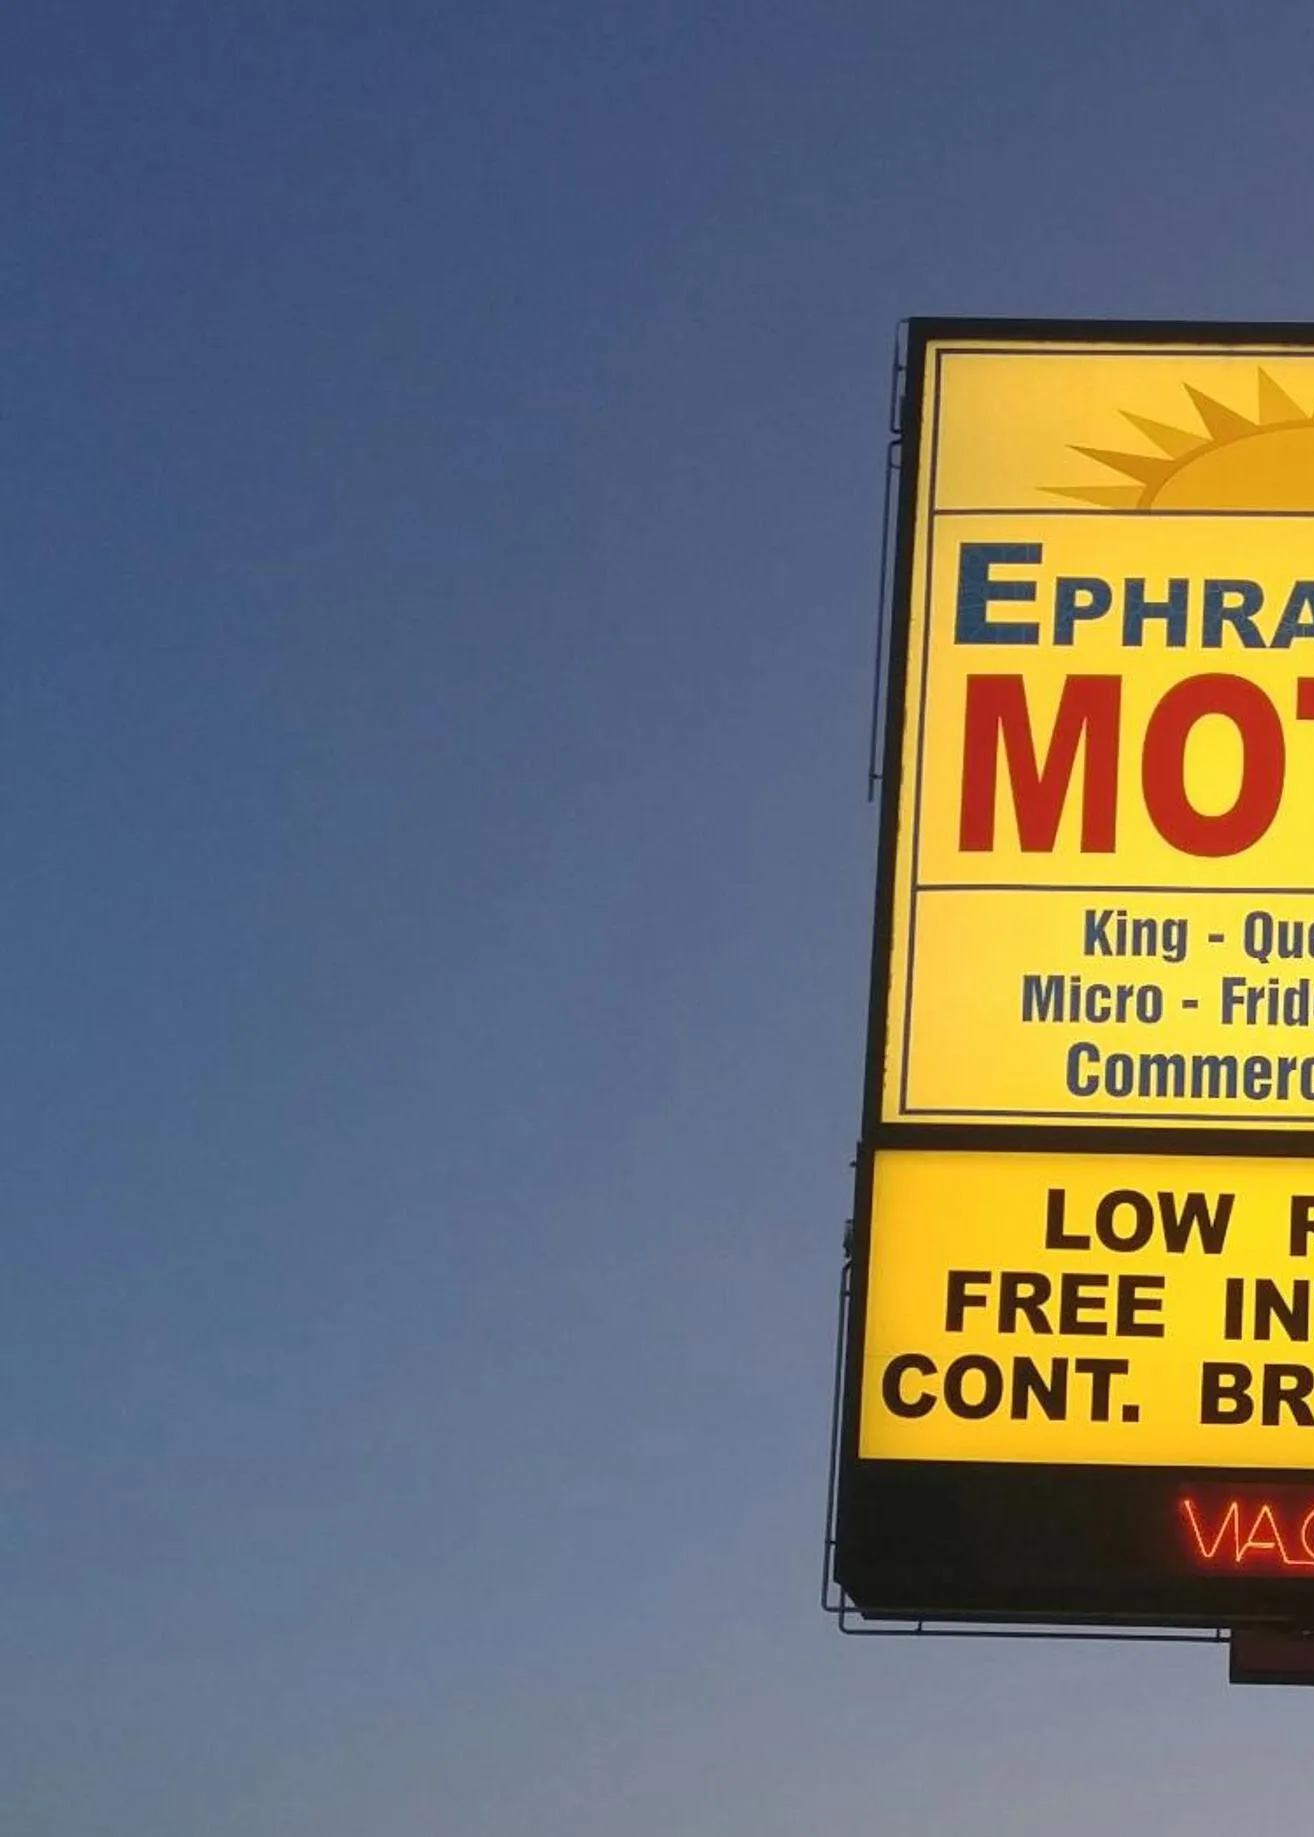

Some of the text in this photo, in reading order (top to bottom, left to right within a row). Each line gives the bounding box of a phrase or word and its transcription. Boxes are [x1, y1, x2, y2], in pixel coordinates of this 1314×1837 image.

[1084, 909, 1188, 963] King
[1022, 975, 1162, 1024] Micro
[1045, 1188, 1236, 1255] LOW
[944, 1269, 1166, 1338] FREE
[881, 1353, 1140, 1423] CONT.
